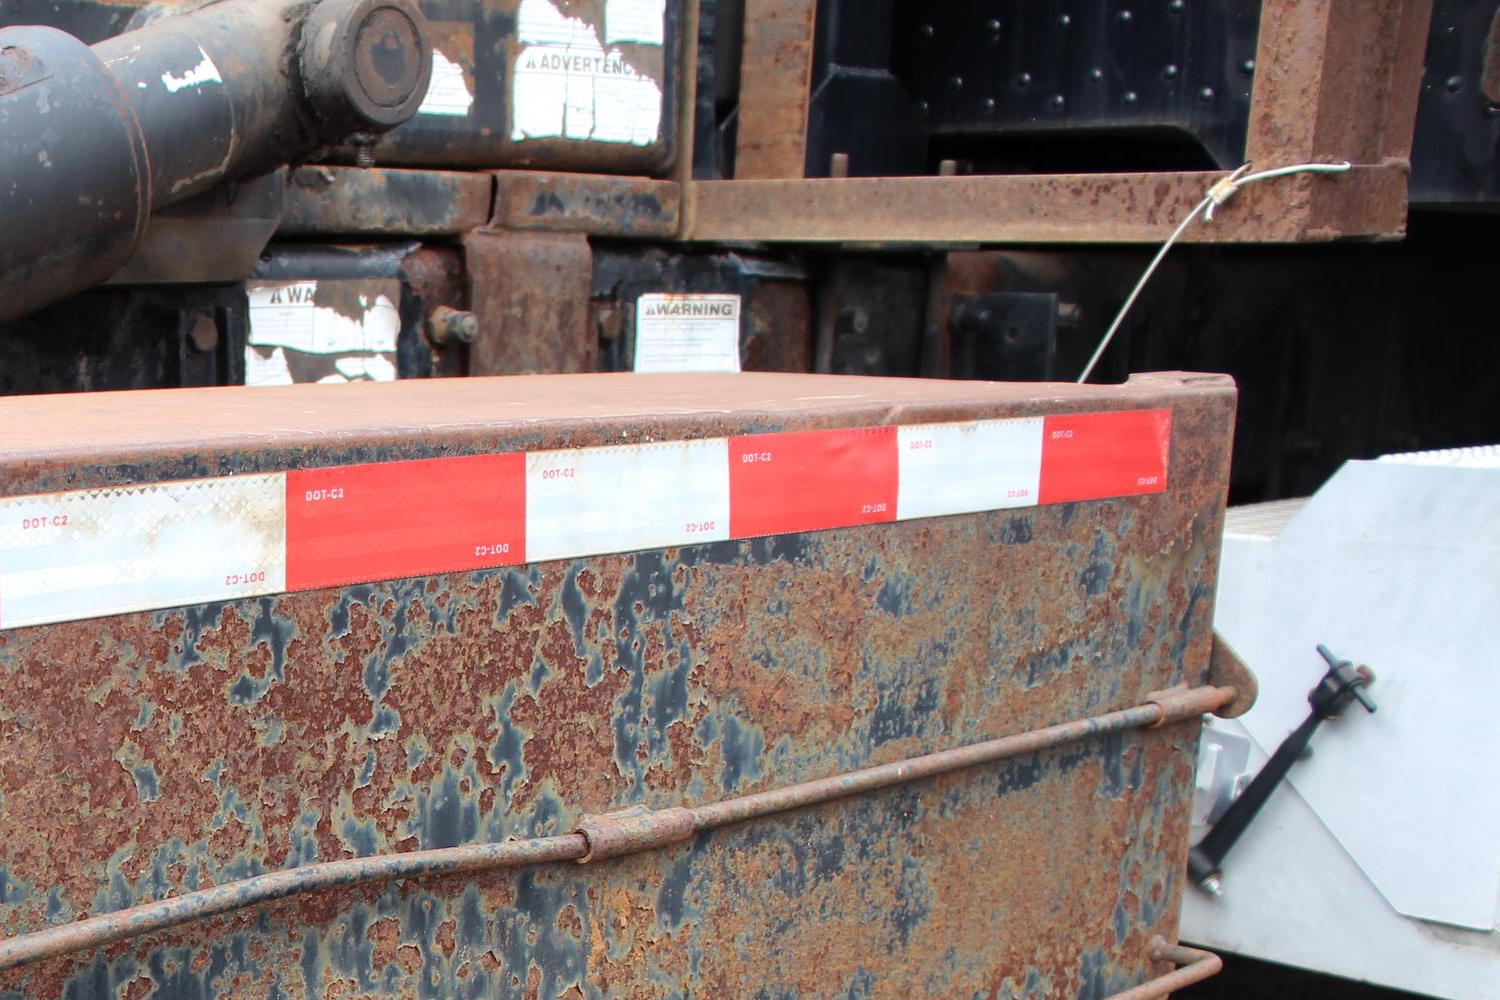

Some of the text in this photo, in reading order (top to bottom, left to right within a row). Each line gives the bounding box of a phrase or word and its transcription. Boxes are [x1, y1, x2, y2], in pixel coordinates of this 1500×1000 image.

[656, 303, 733, 316] WARNING
[742, 452, 771, 463] DOT-C2
[542, 468, 575, 480] DOT-C2
[305, 488, 344, 501] DOT-C2
[22, 515, 68, 529] DOT-C2
[686, 521, 715, 532] DOT-C2
[475, 543, 509, 556] DOT-C2
[225, 571, 266, 586] DOT-C2
